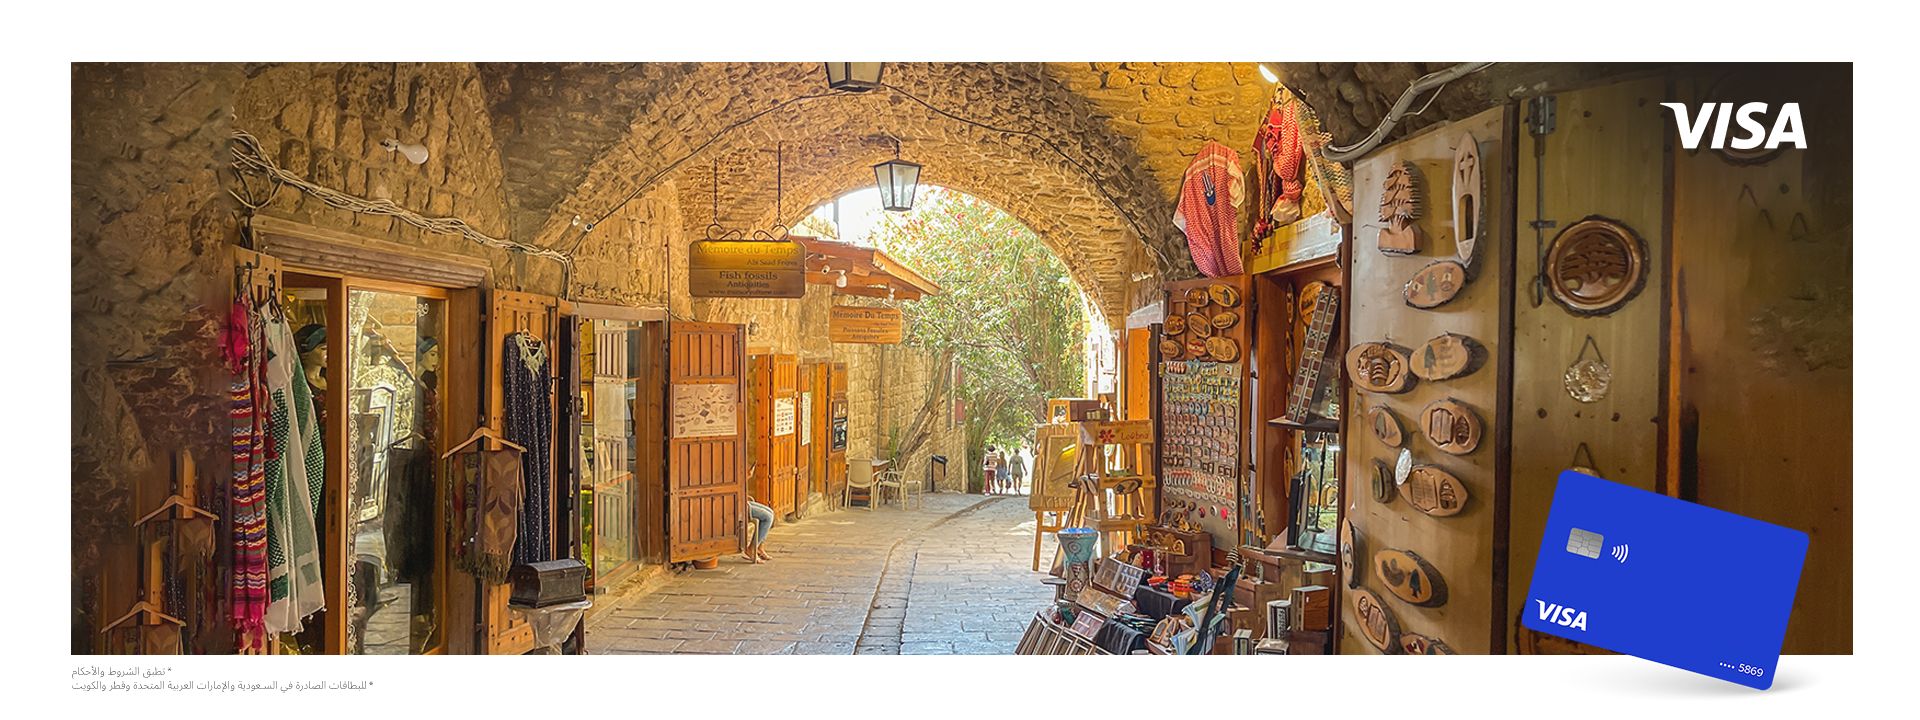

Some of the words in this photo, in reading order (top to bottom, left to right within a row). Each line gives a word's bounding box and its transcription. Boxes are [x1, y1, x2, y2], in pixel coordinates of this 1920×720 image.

[746, 243, 761, 254] du
[765, 244, 799, 256] Temps
[720, 270, 742, 280] Fish
[744, 270, 778, 280] fossils
[865, 311, 875, 319] Du
[876, 311, 899, 321] Temps
